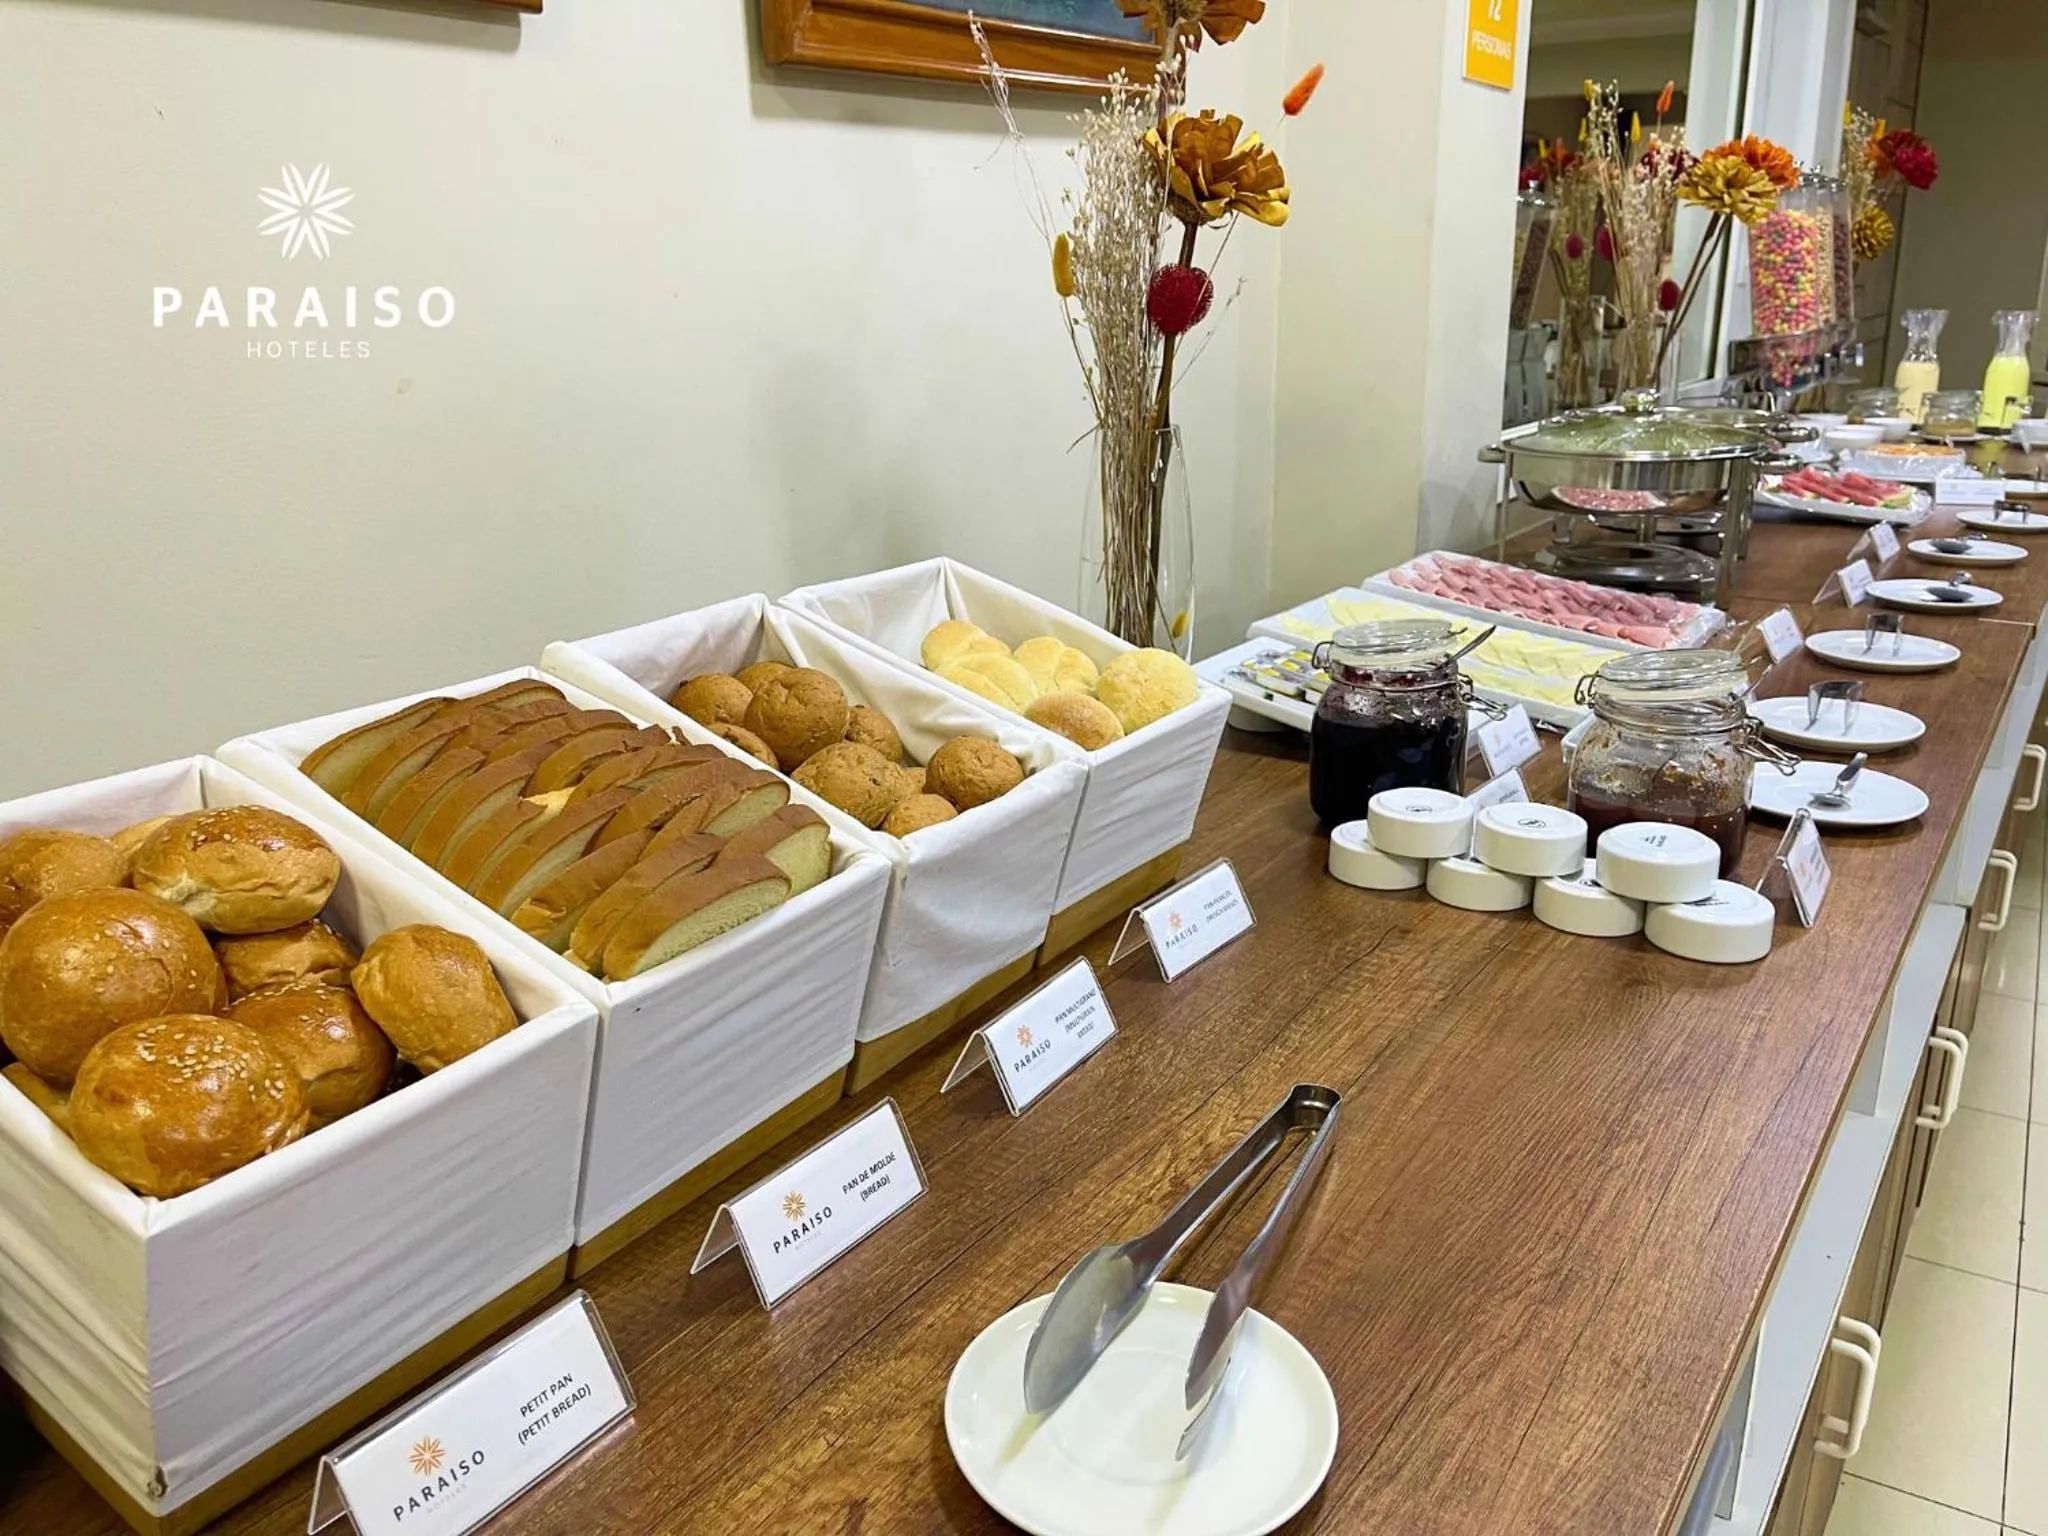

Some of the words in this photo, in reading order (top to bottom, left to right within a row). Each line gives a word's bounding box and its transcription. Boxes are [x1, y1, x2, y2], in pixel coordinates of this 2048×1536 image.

[1471, 29, 1512, 60] PERSONAS
[1014, 1038, 1051, 1073] PARAISO
[841, 1177, 860, 1195] PAN
[858, 1169, 870, 1183] DE
[868, 1151, 897, 1175] MOLDE
[859, 1173, 891, 1202] (BREAD)
[773, 1206, 832, 1254] PARAISO
[517, 1411, 552, 1446] (PETIT
[551, 1383, 592, 1419] BREAD)
[519, 1388, 550, 1418] PETIT
[549, 1372, 574, 1396] PAN
[392, 1449, 486, 1522] PARAISO
